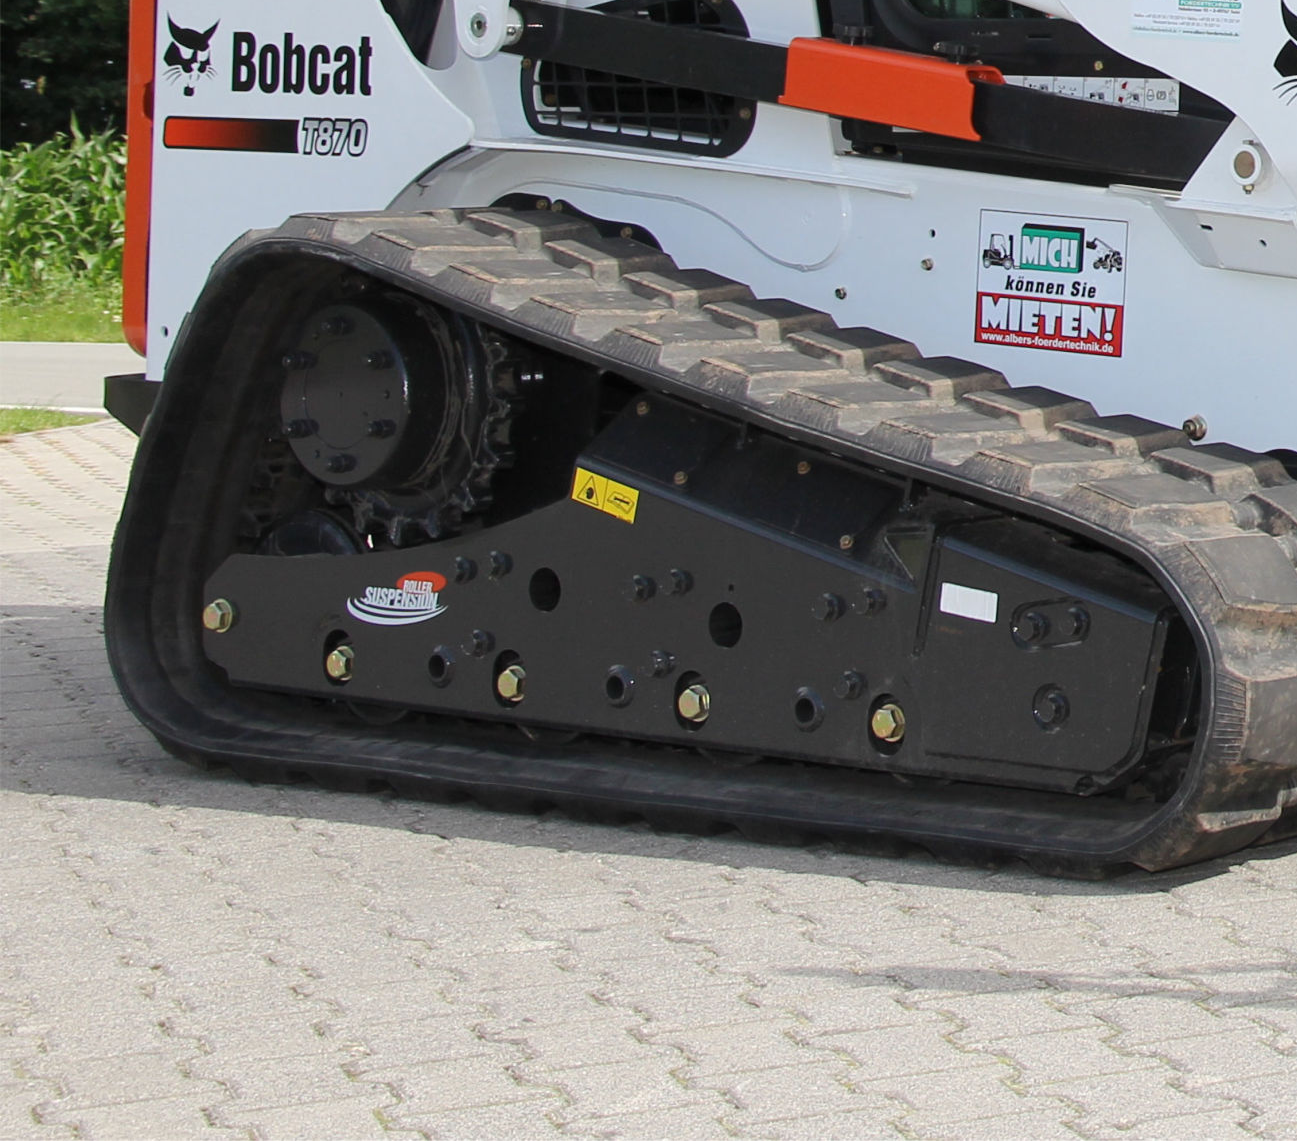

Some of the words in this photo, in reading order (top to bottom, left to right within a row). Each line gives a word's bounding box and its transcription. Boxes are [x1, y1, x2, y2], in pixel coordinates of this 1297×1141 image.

[231, 31, 373, 96] Bobcat
[302, 117, 368, 157] T870
[1021, 235, 1079, 269] MICH
[1005, 275, 1065, 296] können
[1071, 281, 1097, 299] Sie
[980, 295, 1117, 342] MIETEN!
[981, 331, 1114, 354] www.albers-foerdertechnik.de
[365, 586, 440, 610] SUSPENSION
[403, 579, 433, 594] ROLLER
